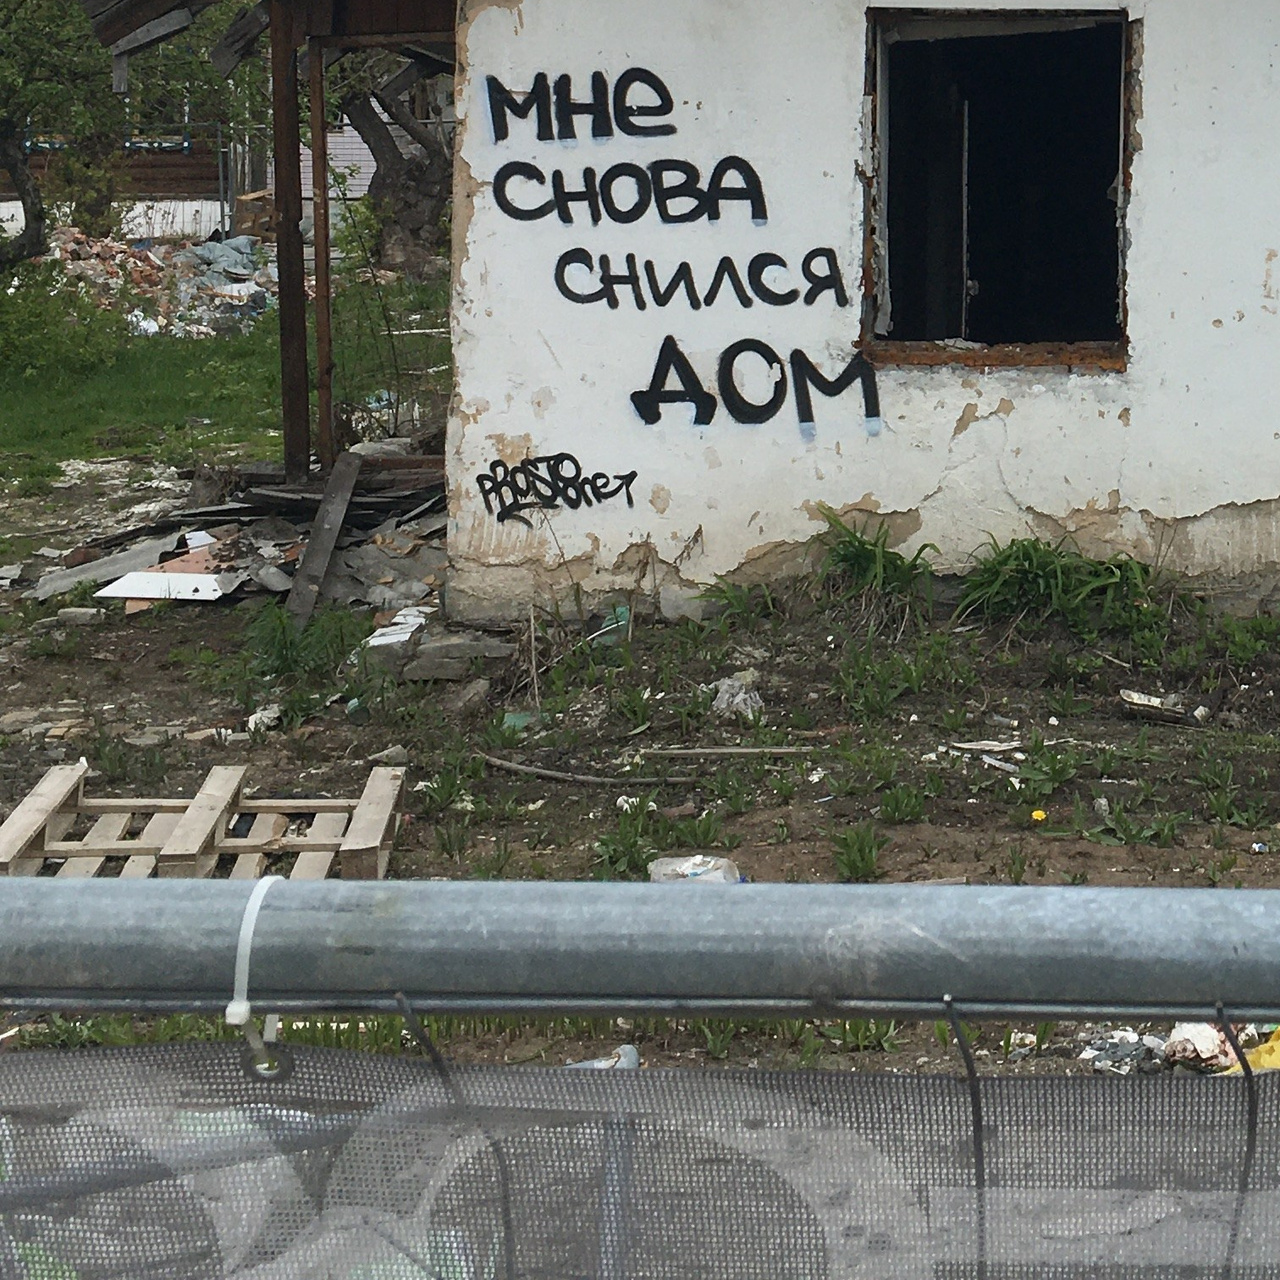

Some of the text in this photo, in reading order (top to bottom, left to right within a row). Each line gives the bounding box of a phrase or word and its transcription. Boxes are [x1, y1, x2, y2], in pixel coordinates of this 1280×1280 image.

[492, 155, 768, 225] СНОВА
[554, 246, 848, 310] СНИЛСЯ
[629, 335, 881, 427] ДОМ
